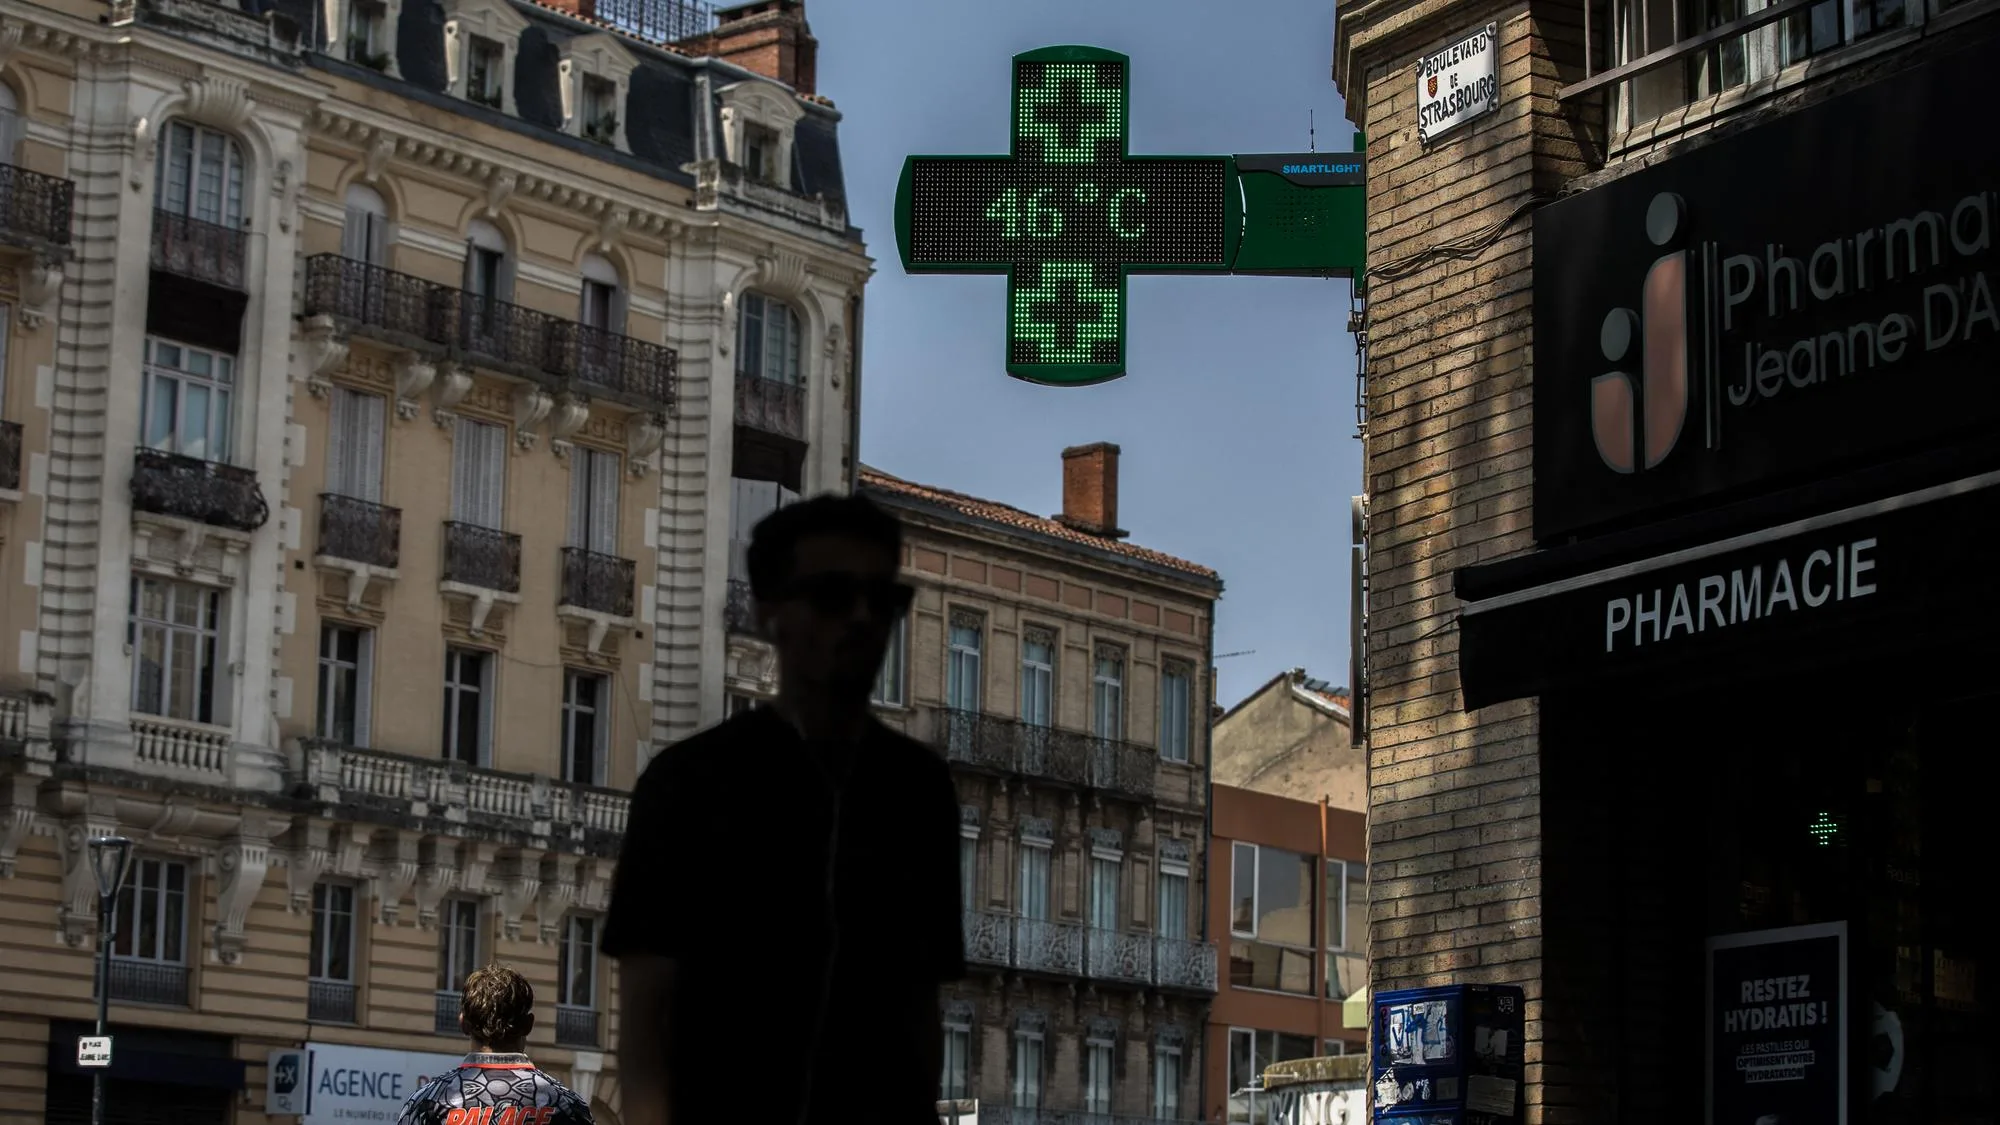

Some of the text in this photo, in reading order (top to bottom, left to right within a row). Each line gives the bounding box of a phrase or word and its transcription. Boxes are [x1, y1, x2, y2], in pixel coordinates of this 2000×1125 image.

[1426, 33, 1487, 78] BOULEVARD
[1450, 72, 1458, 89] DE
[1420, 73, 1495, 128] STRASBOURG
[1282, 164, 1360, 174] SMARTLIGHT
[1728, 312, 1908, 406] Jeanne
[1606, 537, 1877, 653] PHARMACIE
[1741, 974, 1811, 1004] RESTEZ
[1724, 1002, 1818, 1033] HYDRATIS
[1737, 1052, 1814, 1068] OPTIMISENT VOTRE
[1741, 1039, 1810, 1054] LES PASTILLES QUI
[319, 1068, 402, 1100] AGENCE
[1747, 1067, 1805, 1081] HYDRATATION
[446, 1106, 556, 1125] PALACE
